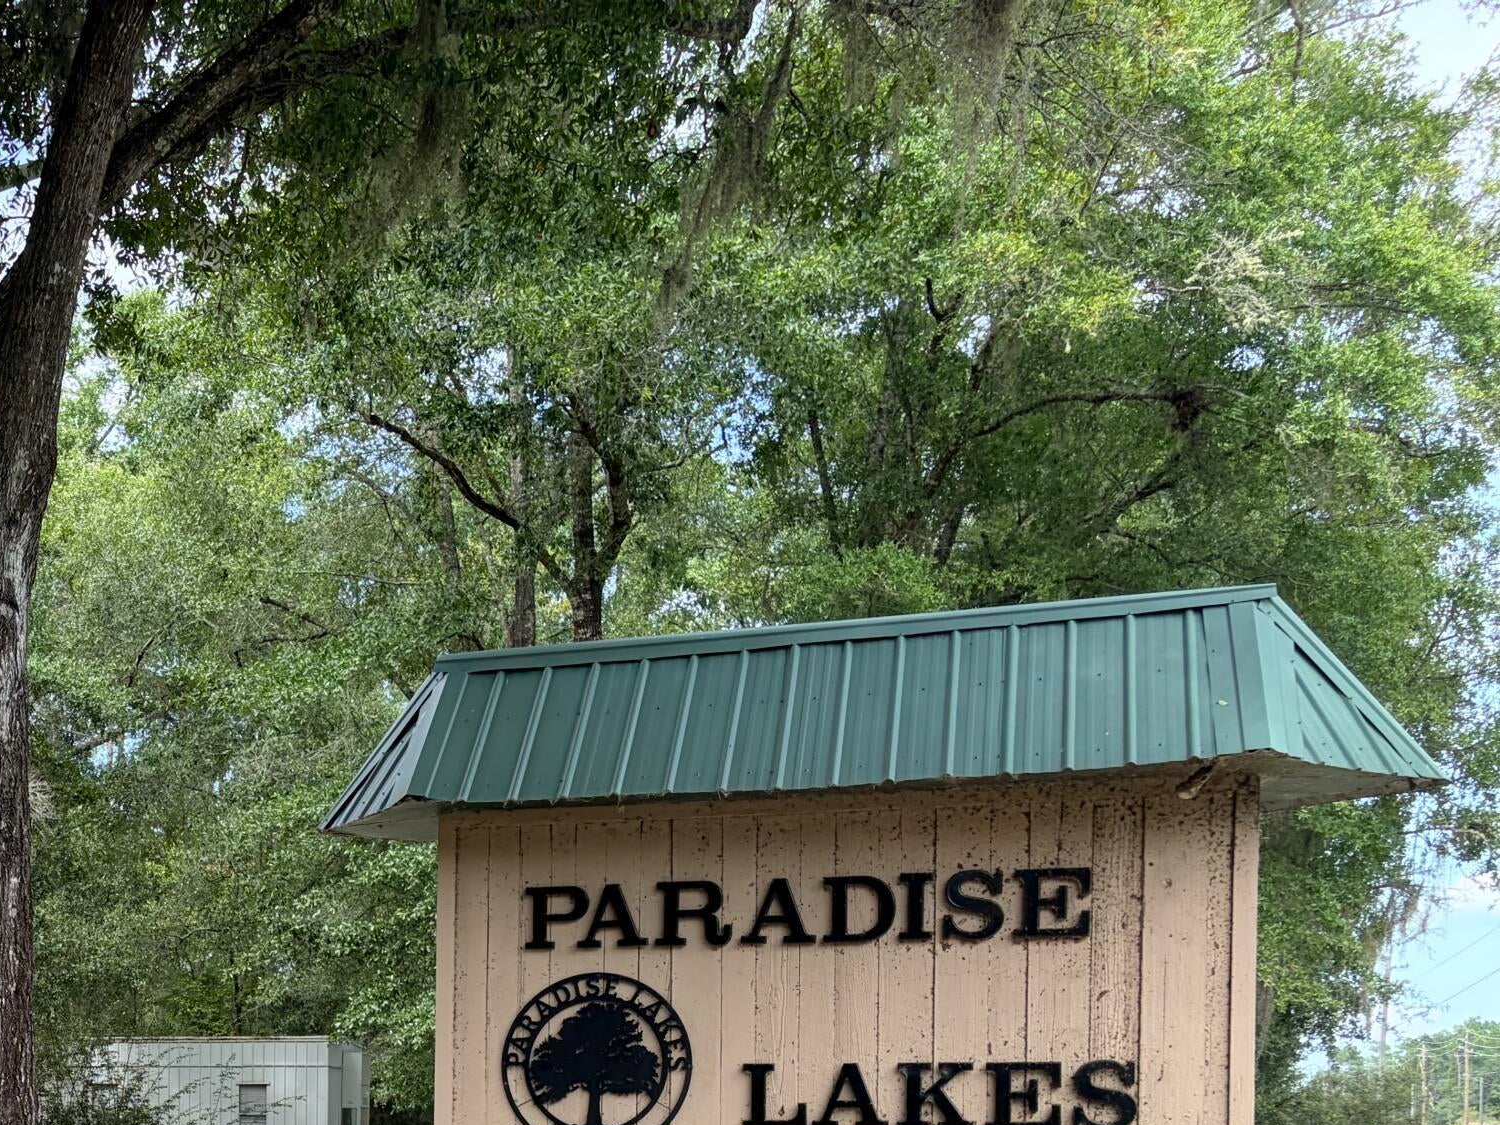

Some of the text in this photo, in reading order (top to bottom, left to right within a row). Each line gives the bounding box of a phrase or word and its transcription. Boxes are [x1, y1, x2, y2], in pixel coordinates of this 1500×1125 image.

[524, 867, 1093, 950] PARADISE
[506, 978, 687, 1071] PARADISE LAKES
